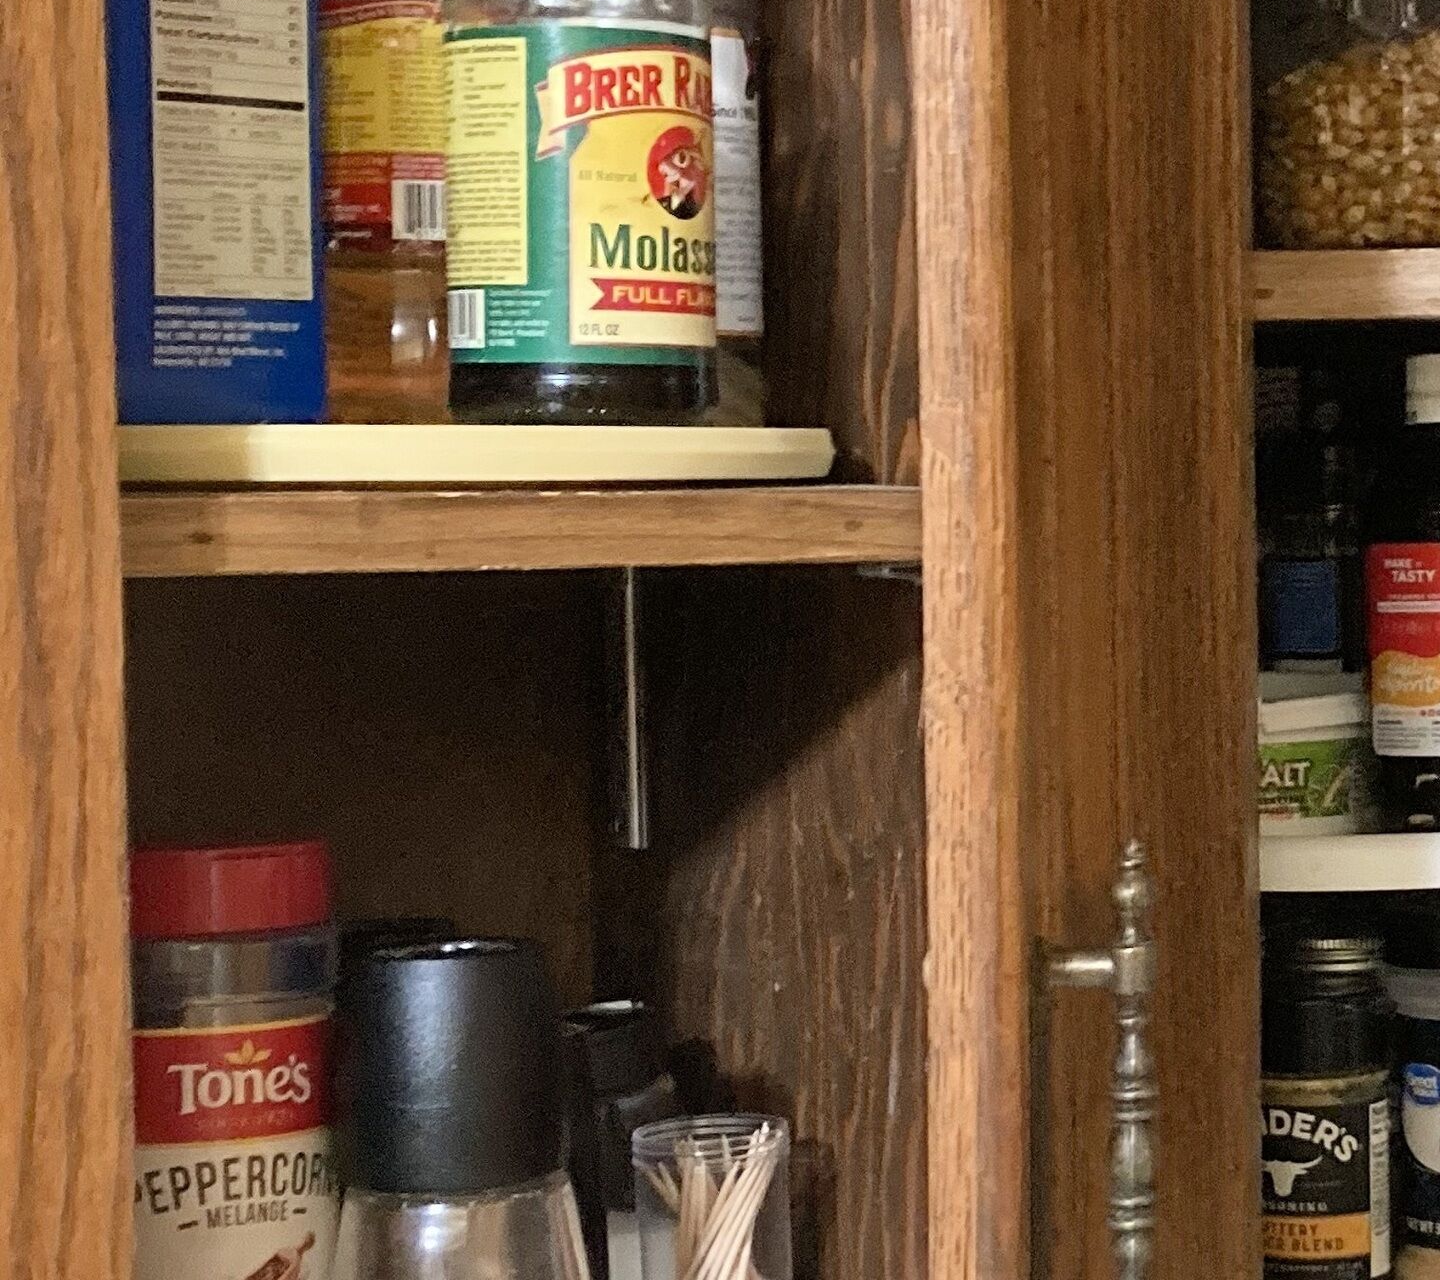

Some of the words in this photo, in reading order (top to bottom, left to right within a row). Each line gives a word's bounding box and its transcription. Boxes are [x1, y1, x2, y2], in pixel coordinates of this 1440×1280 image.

[563, 62, 664, 119] BRER
[612, 286, 672, 305] FULL
[1391, 569, 1437, 583] TASTY
[1260, 757, 1311, 788] ALT
[166, 1053, 313, 1117] Tone's
[1262, 1108, 1359, 1162] DER'S
[206, 1200, 289, 1229] MELANGE
[1292, 1237, 1344, 1252] BLEND
